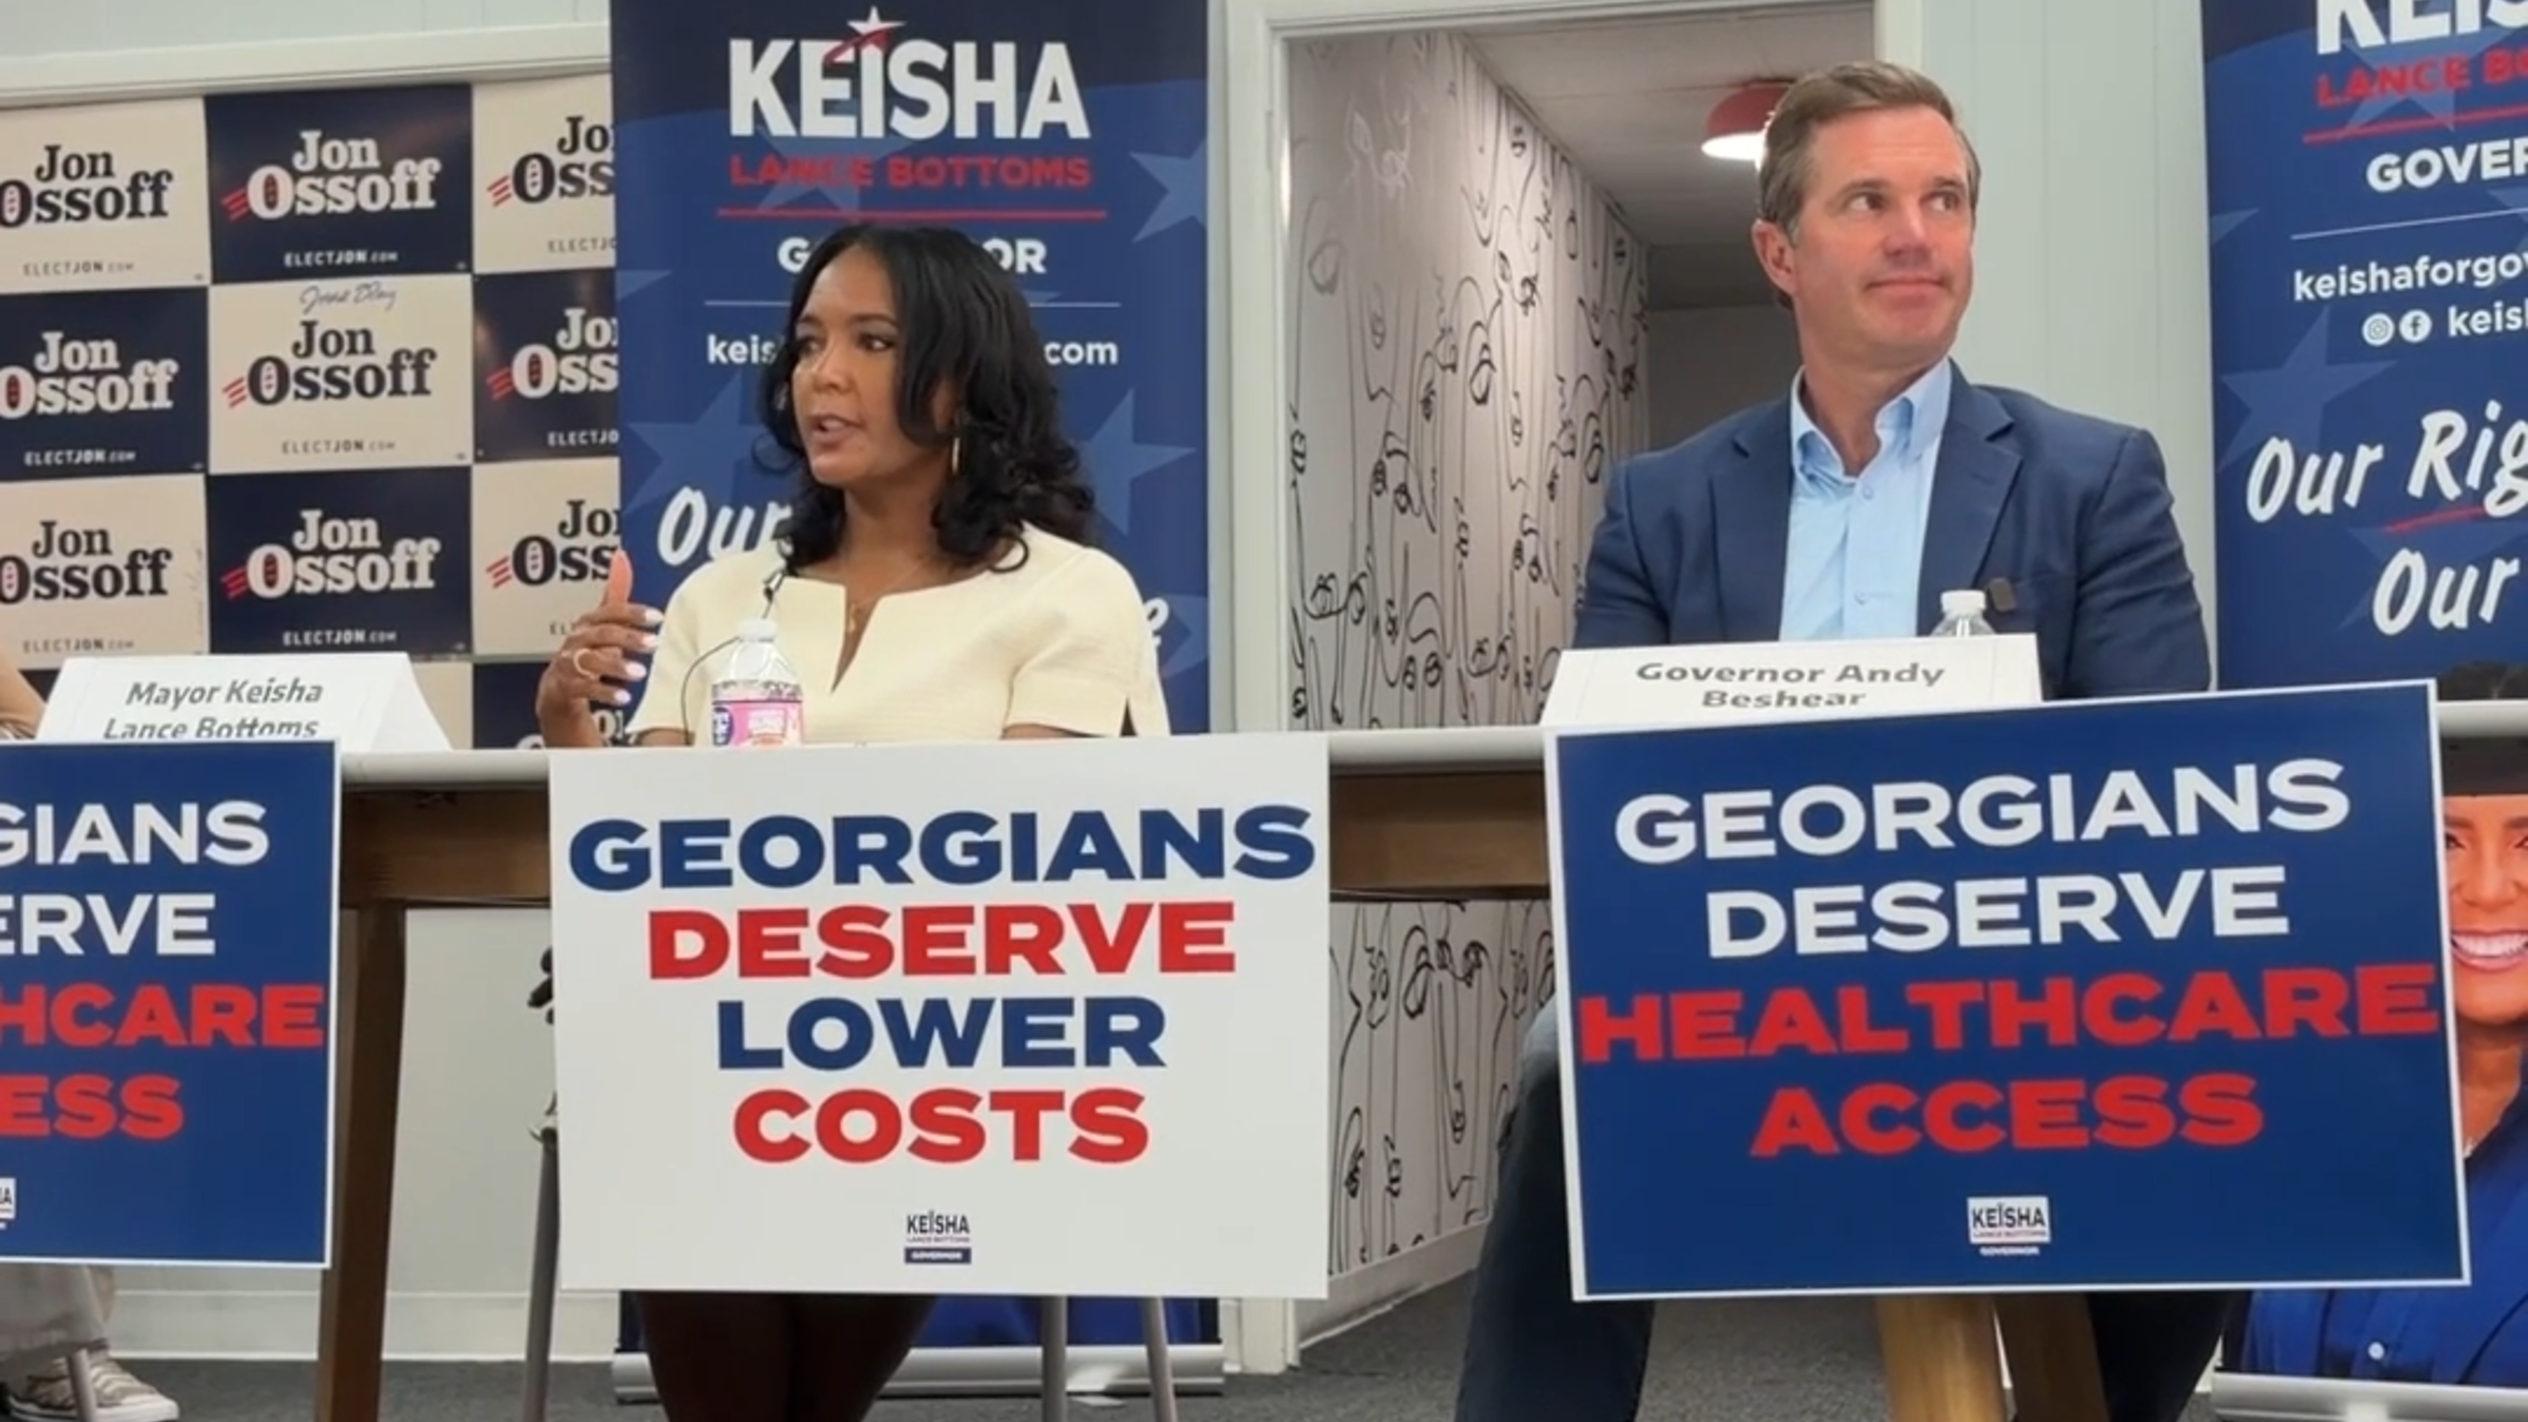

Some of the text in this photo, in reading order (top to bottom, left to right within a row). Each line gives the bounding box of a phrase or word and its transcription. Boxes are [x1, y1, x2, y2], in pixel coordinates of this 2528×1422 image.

[729, 39, 1091, 139] KEISHA
[2316, 55, 2470, 108] LANCE
[35, 145, 116, 183] Jon
[292, 130, 381, 172] Jon
[511, 152, 616, 204] Oss
[730, 154, 1092, 188] LANCE BOTTOMS
[0, 169, 173, 228] Ossoff
[247, 157, 442, 220] Ossoff
[291, 320, 376, 359] Jon
[2449, 298, 2528, 337] keis
[34, 331, 121, 373] Jon
[247, 347, 438, 406] Ossoff
[510, 344, 619, 398] Oss
[0, 358, 180, 419] Ossoff
[2246, 436, 2384, 522] Our
[32, 520, 113, 558] Jon
[292, 509, 381, 551] Jon
[657, 486, 792, 567] Our
[0, 548, 173, 605] Ossoff
[247, 537, 441, 598] Ossoff
[2373, 548, 2520, 635] Our
[126, 677, 323, 711] Mayor Keisha
[1637, 662, 1946, 687] Governor Andy
[1701, 690, 1866, 708] Beshear
[103, 716, 319, 739] Lance Bottoms
[1616, 759, 2350, 864] GEORGIANS
[569, 805, 1315, 891] GEORGIANS
[0, 894, 216, 955] RVE
[649, 902, 1235, 979] DESERVE
[1707, 866, 2289, 958] DESERVE
[718, 996, 1166, 1071] LOWER
[1580, 964, 2439, 1062] HEALTHCARE
[0, 1074, 185, 1140] ESS
[734, 1089, 1149, 1163] COSTS
[1751, 1074, 2264, 1157] ACCESS
[906, 1210, 970, 1234] KEISHA
[1972, 1202, 2046, 1228] KEISHA
